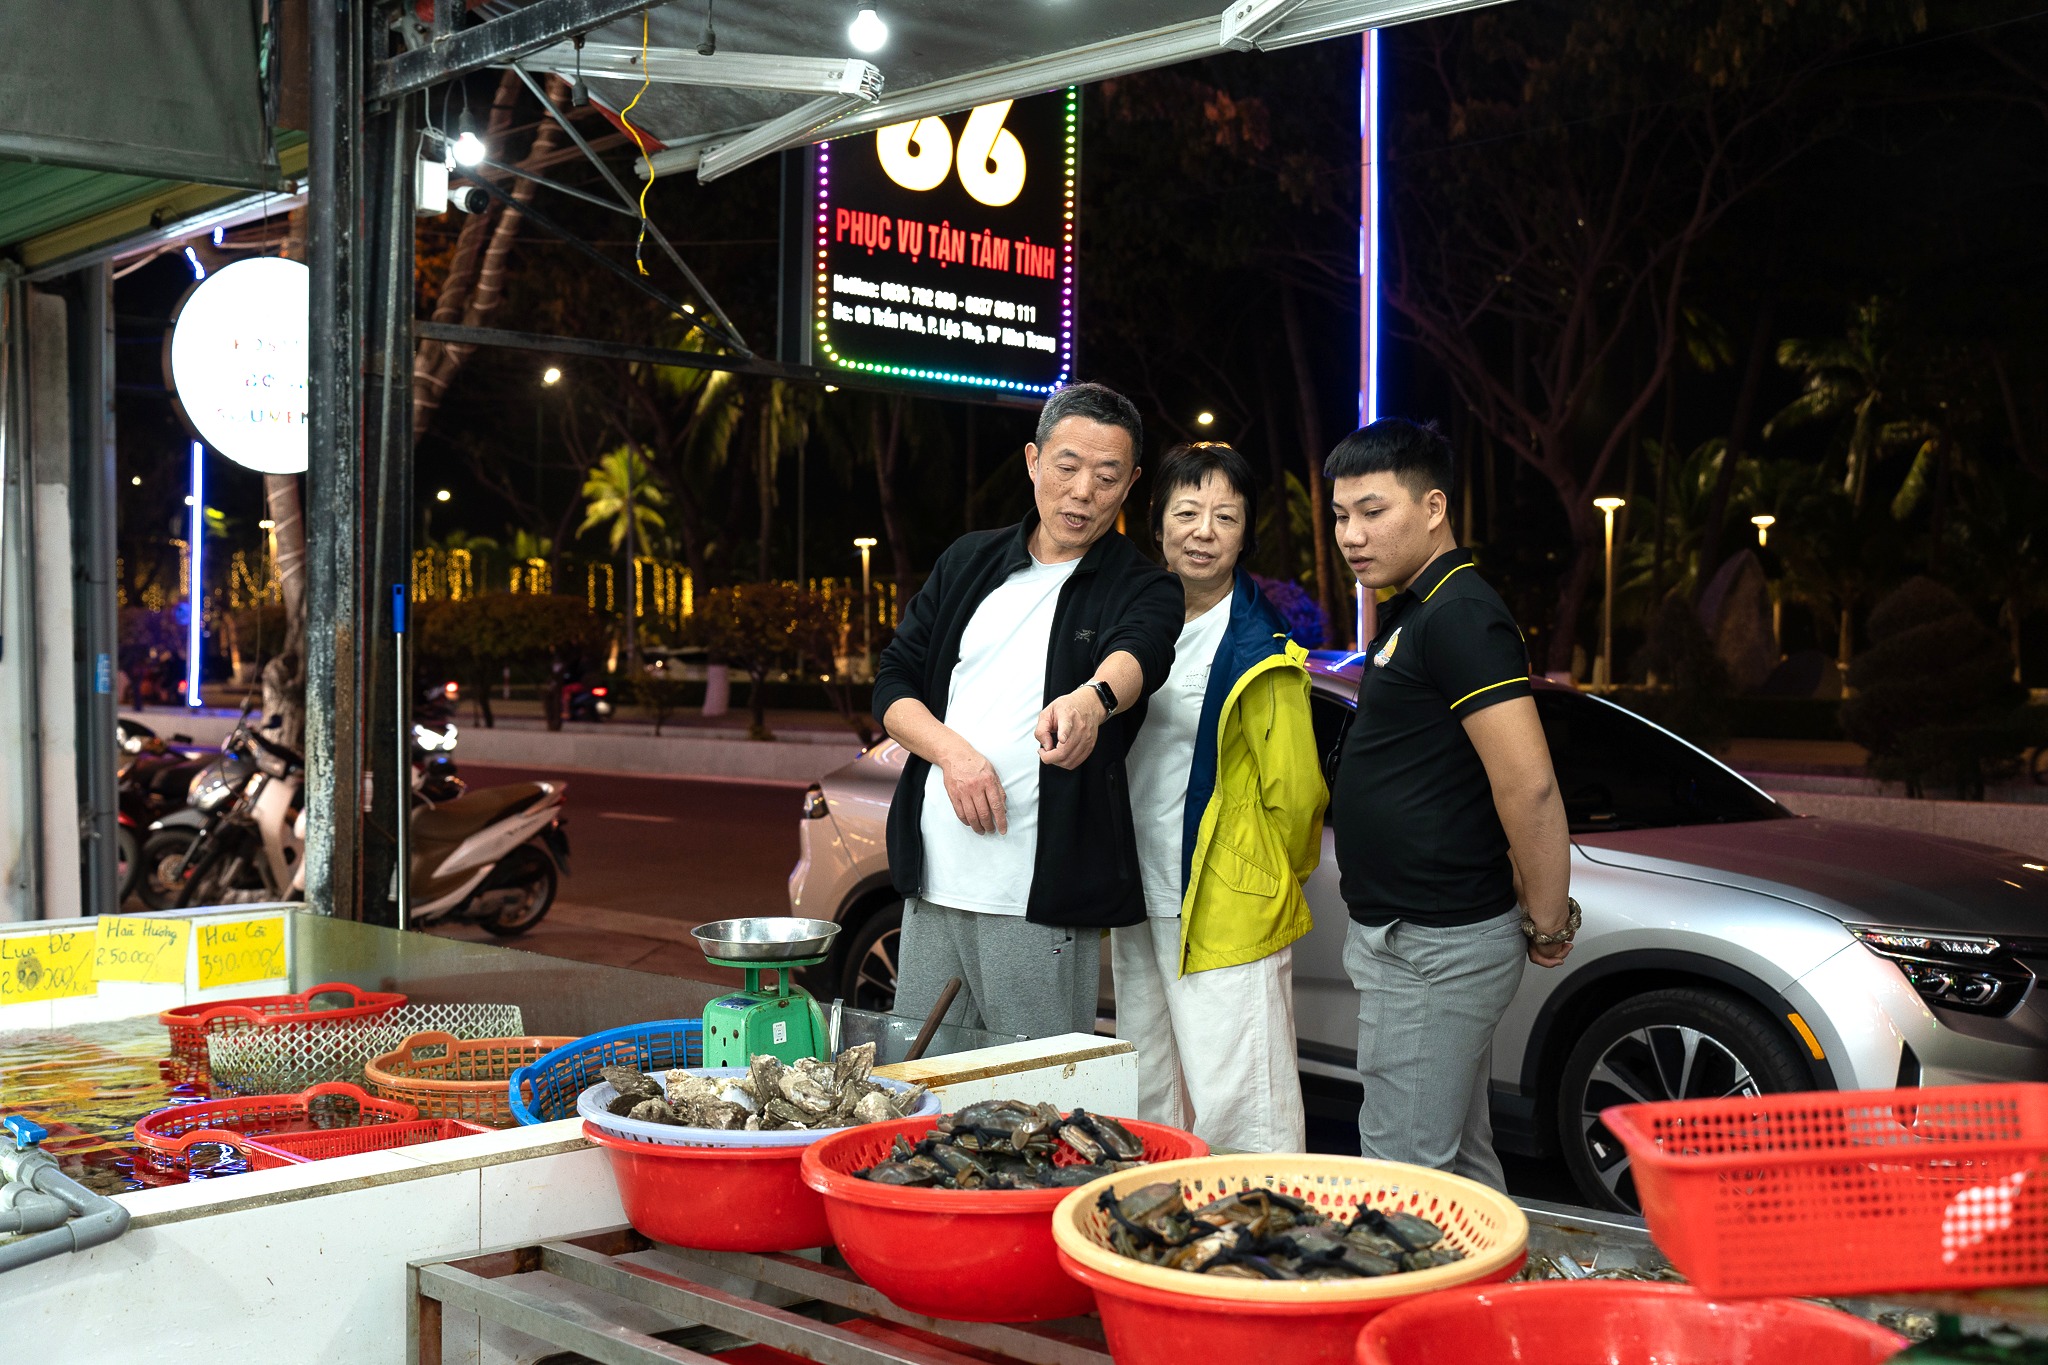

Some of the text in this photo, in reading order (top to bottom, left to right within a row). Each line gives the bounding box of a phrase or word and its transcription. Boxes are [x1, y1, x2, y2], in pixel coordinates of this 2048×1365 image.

[876, 99, 1027, 207] 66
[836, 208, 1056, 280] PHỤC VỤ TẬN TÂM TÌNH
[1016, 304, 1036, 324] 111
[927, 315, 938, 335] P.
[986, 325, 1001, 344] TP
[205, 924, 238, 947] Hai
